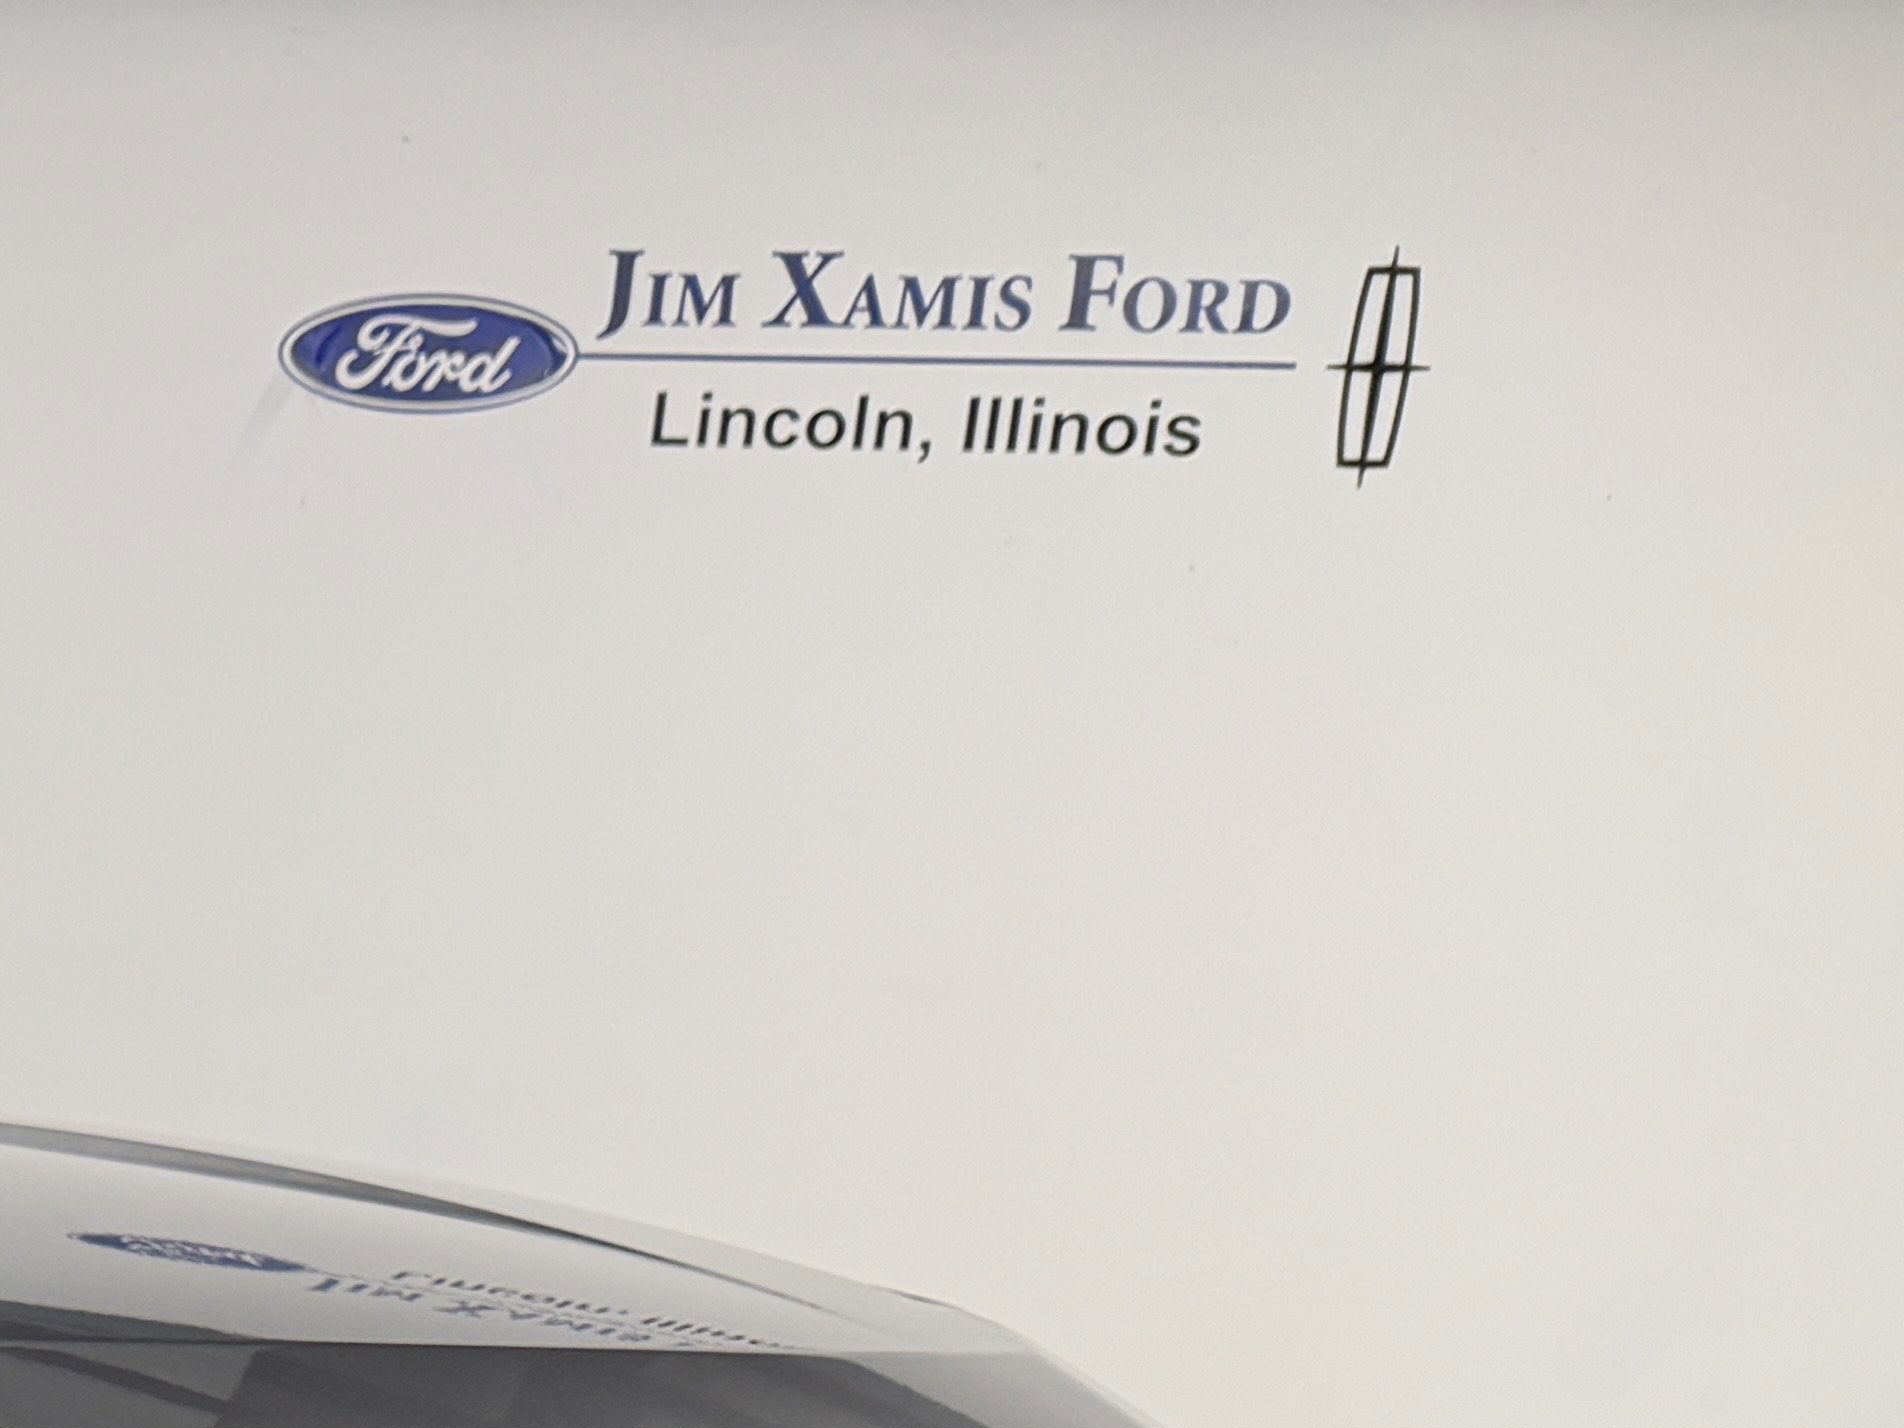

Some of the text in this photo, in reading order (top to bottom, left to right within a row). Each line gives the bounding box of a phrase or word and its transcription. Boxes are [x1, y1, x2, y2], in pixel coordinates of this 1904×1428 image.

[597, 249, 1292, 341] JIM XAMIS FORD
[334, 313, 522, 394] Ford
[650, 391, 1202, 464] Lincoln, Illinois
